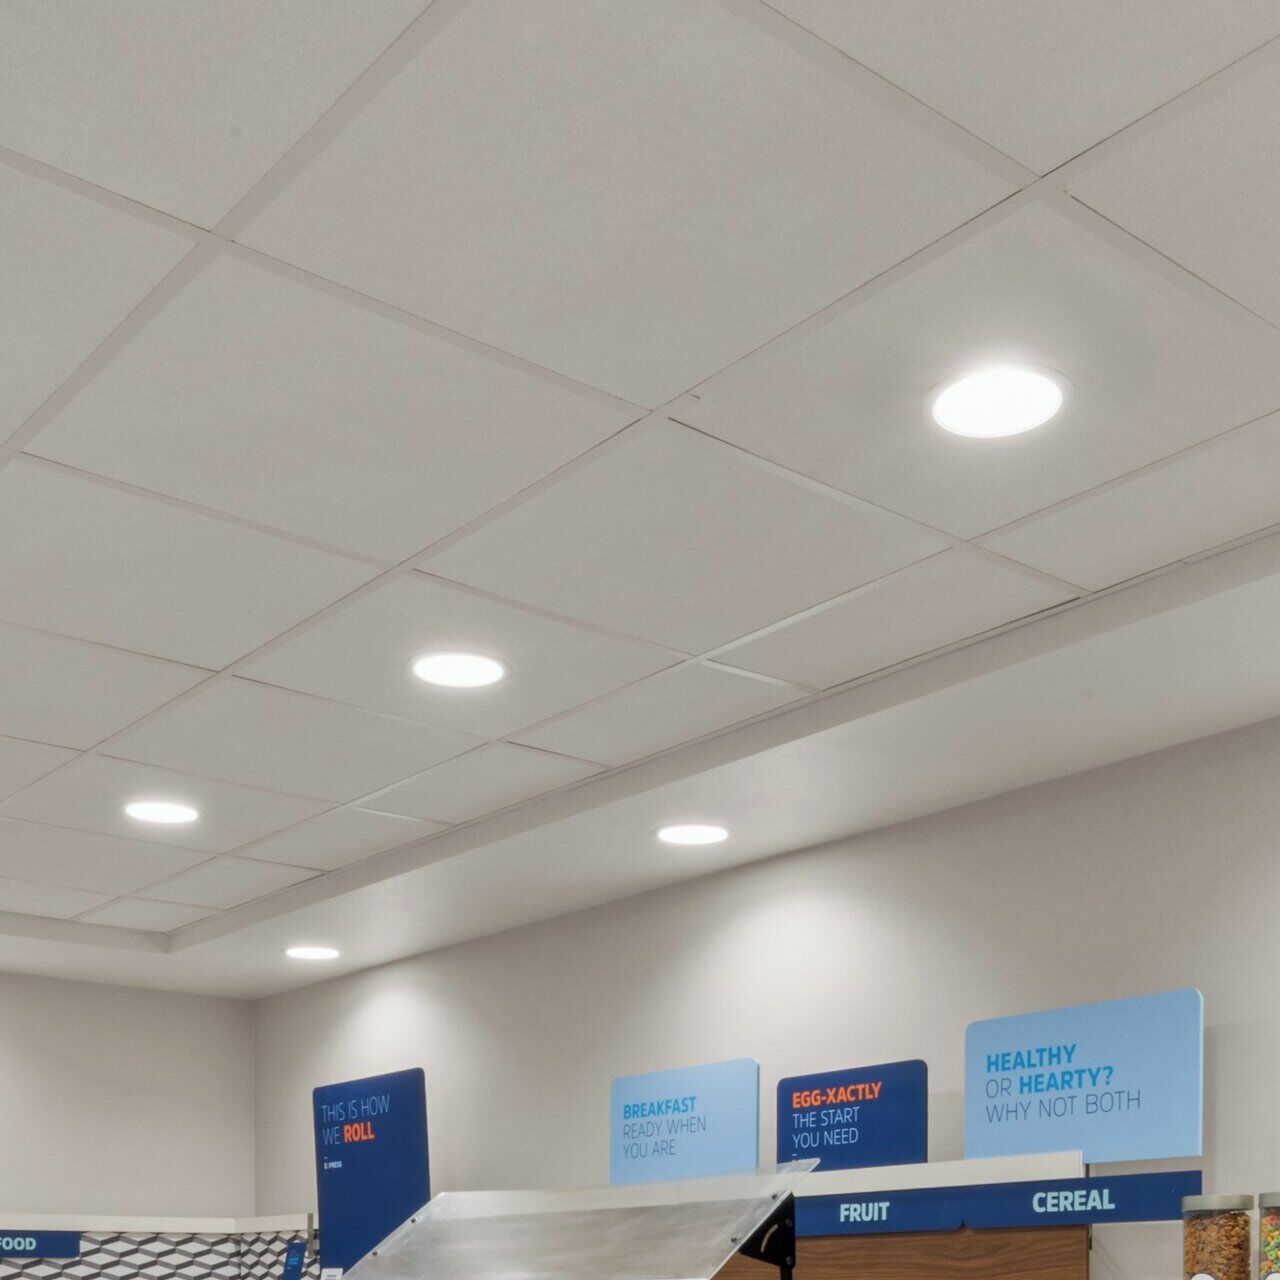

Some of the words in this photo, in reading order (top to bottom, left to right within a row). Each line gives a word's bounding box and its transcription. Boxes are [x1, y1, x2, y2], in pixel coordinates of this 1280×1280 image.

[986, 1043, 1077, 1073] HEALTHY
[985, 1077, 1012, 1099] OR
[1020, 1065, 1114, 1095] HEARTY?
[792, 1081, 882, 1109] EGG-XACTLY
[985, 1101, 1031, 1124] WHY
[1038, 1095, 1078, 1119] NOT
[1085, 1089, 1141, 1115] BOTH
[321, 1102, 345, 1123] THIS
[348, 1099, 358, 1119] IS
[360, 1094, 390, 1117] HOW
[623, 1096, 697, 1120] BREAKFAST
[792, 1111, 817, 1129] THE
[820, 1106, 860, 1127] START
[322, 1126, 340, 1146] WE
[343, 1121, 376, 1143] ROLL
[623, 1120, 663, 1140] READY
[667, 1116, 706, 1135] WHEN
[792, 1131, 819, 1149] YOU
[823, 1127, 859, 1146] NEED
[622, 1141, 648, 1160] YOU
[652, 1139, 676, 1157] ARE
[839, 1201, 890, 1222] FRUIT
[1032, 1189, 1116, 1213] CEREAL
